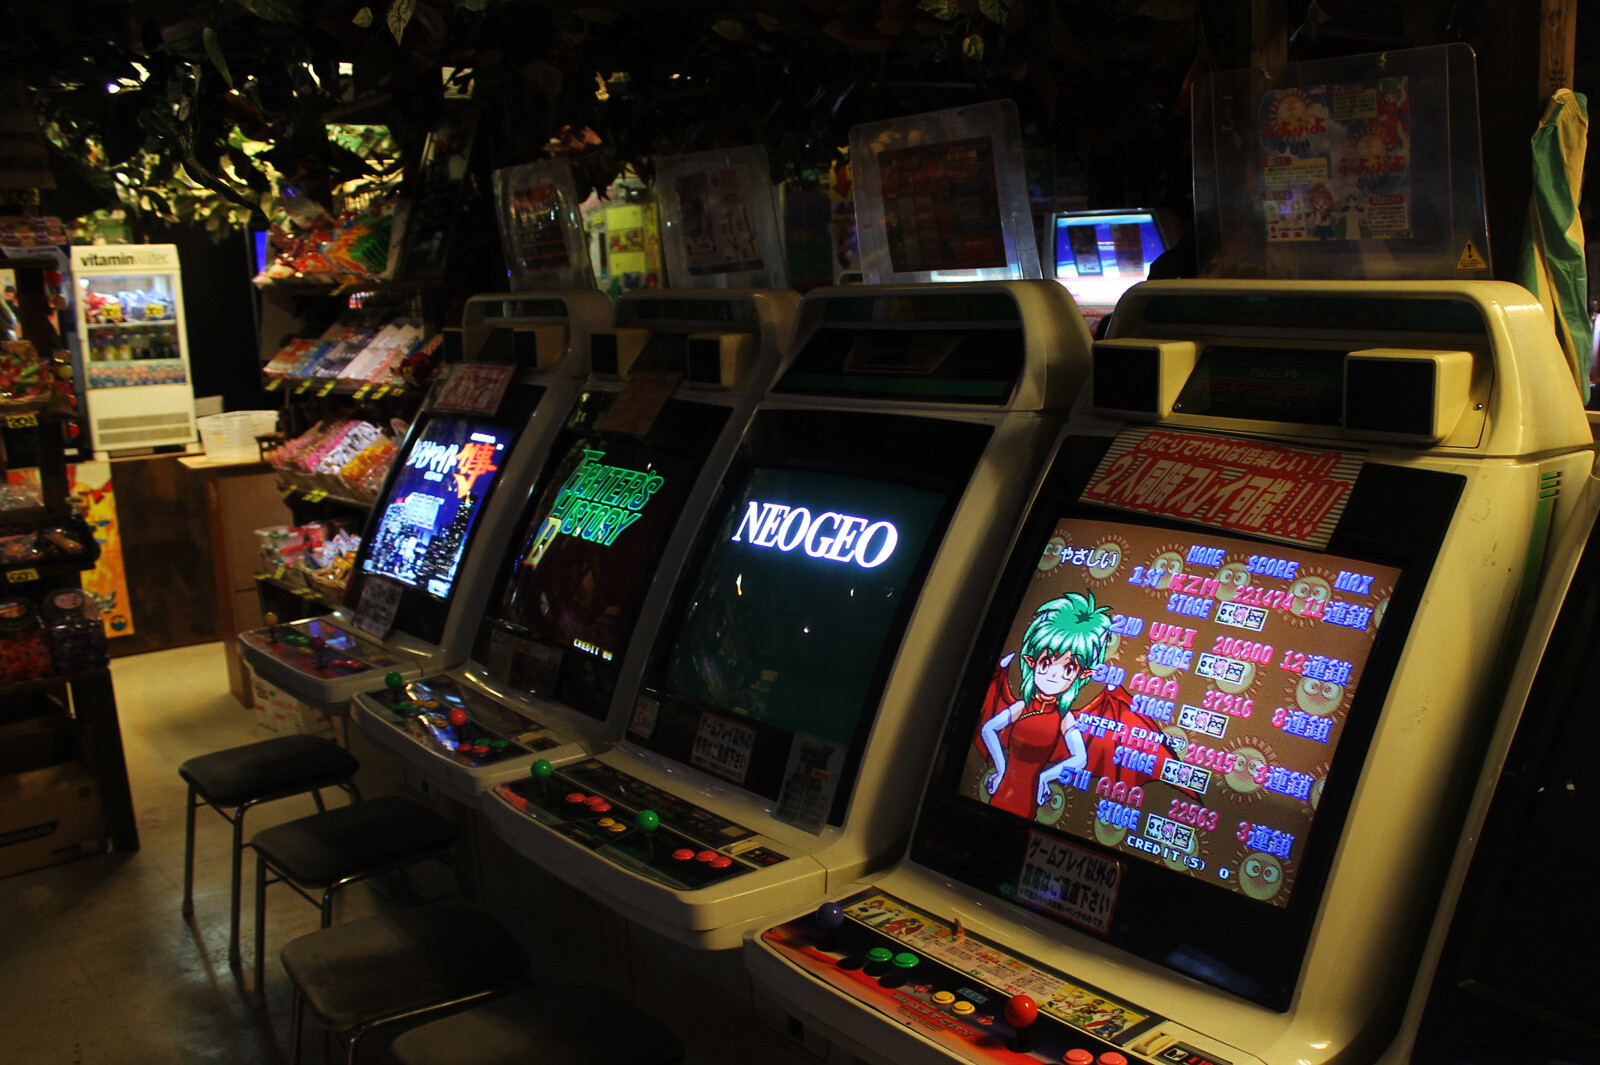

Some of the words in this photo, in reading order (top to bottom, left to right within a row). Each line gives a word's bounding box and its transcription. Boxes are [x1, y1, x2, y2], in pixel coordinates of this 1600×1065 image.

[81, 253, 134, 266] vitamin
[731, 501, 899, 569] NEOGEO
[1060, 546, 1118, 569] やさしい
[1185, 545, 1226, 568] NAME
[1245, 555, 1300, 581] SCORE
[1334, 570, 1375, 595] MAX
[1127, 566, 1166, 588] 1ST
[1167, 572, 1221, 599] KZM
[1232, 584, 1295, 612] 221474
[1166, 593, 1215, 620] STAGE
[1108, 614, 1145, 638] 2ND
[1149, 621, 1198, 649] UMI
[1212, 635, 1275, 665] 206800
[1147, 643, 1194, 671] STAGE
[1129, 672, 1180, 701] AAA
[1202, 689, 1255, 719] 37916
[1129, 693, 1176, 722] STAGE
[1079, 712, 1126, 733] INSERT
[1131, 726, 1187, 751] COIN(S)
[1112, 745, 1158, 776] STAGE
[1184, 743, 1239, 773] 26915
[1057, 765, 1093, 791] 5TH
[1094, 775, 1145, 808] AAA
[1167, 798, 1220, 832] 22563
[1095, 798, 1142, 831] STAGE
[1126, 835, 1207, 871] CREDIT(S)
